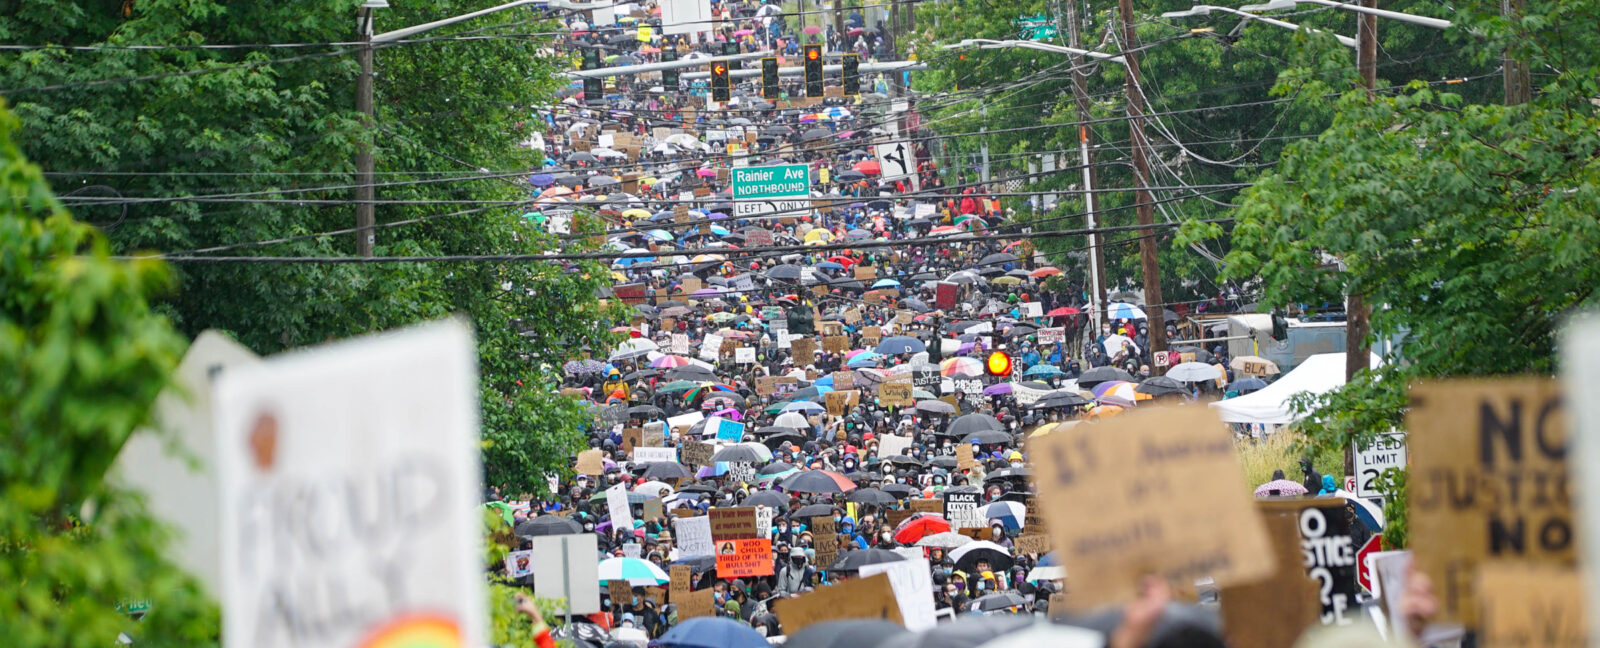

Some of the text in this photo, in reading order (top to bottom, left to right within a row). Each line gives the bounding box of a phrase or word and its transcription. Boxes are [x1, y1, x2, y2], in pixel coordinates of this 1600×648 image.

[737, 168, 804, 182] Rainier Ave
[738, 182, 804, 195] NORTHBOUND
[738, 202, 806, 214] LEFT ONLY
[1244, 362, 1266, 376] BLM
[914, 375, 941, 386] JUSTICE
[1366, 440, 1402, 450] PEED
[730, 461, 752, 469] BLACK
[1364, 454, 1398, 465] LIMIT
[950, 494, 975, 502] BLACK
[814, 523, 834, 534] BLACK
[1488, 513, 1572, 555] NO
[680, 542, 706, 552] VOTE
[815, 541, 836, 551] LIVES
[1300, 534, 1354, 568] STICE
